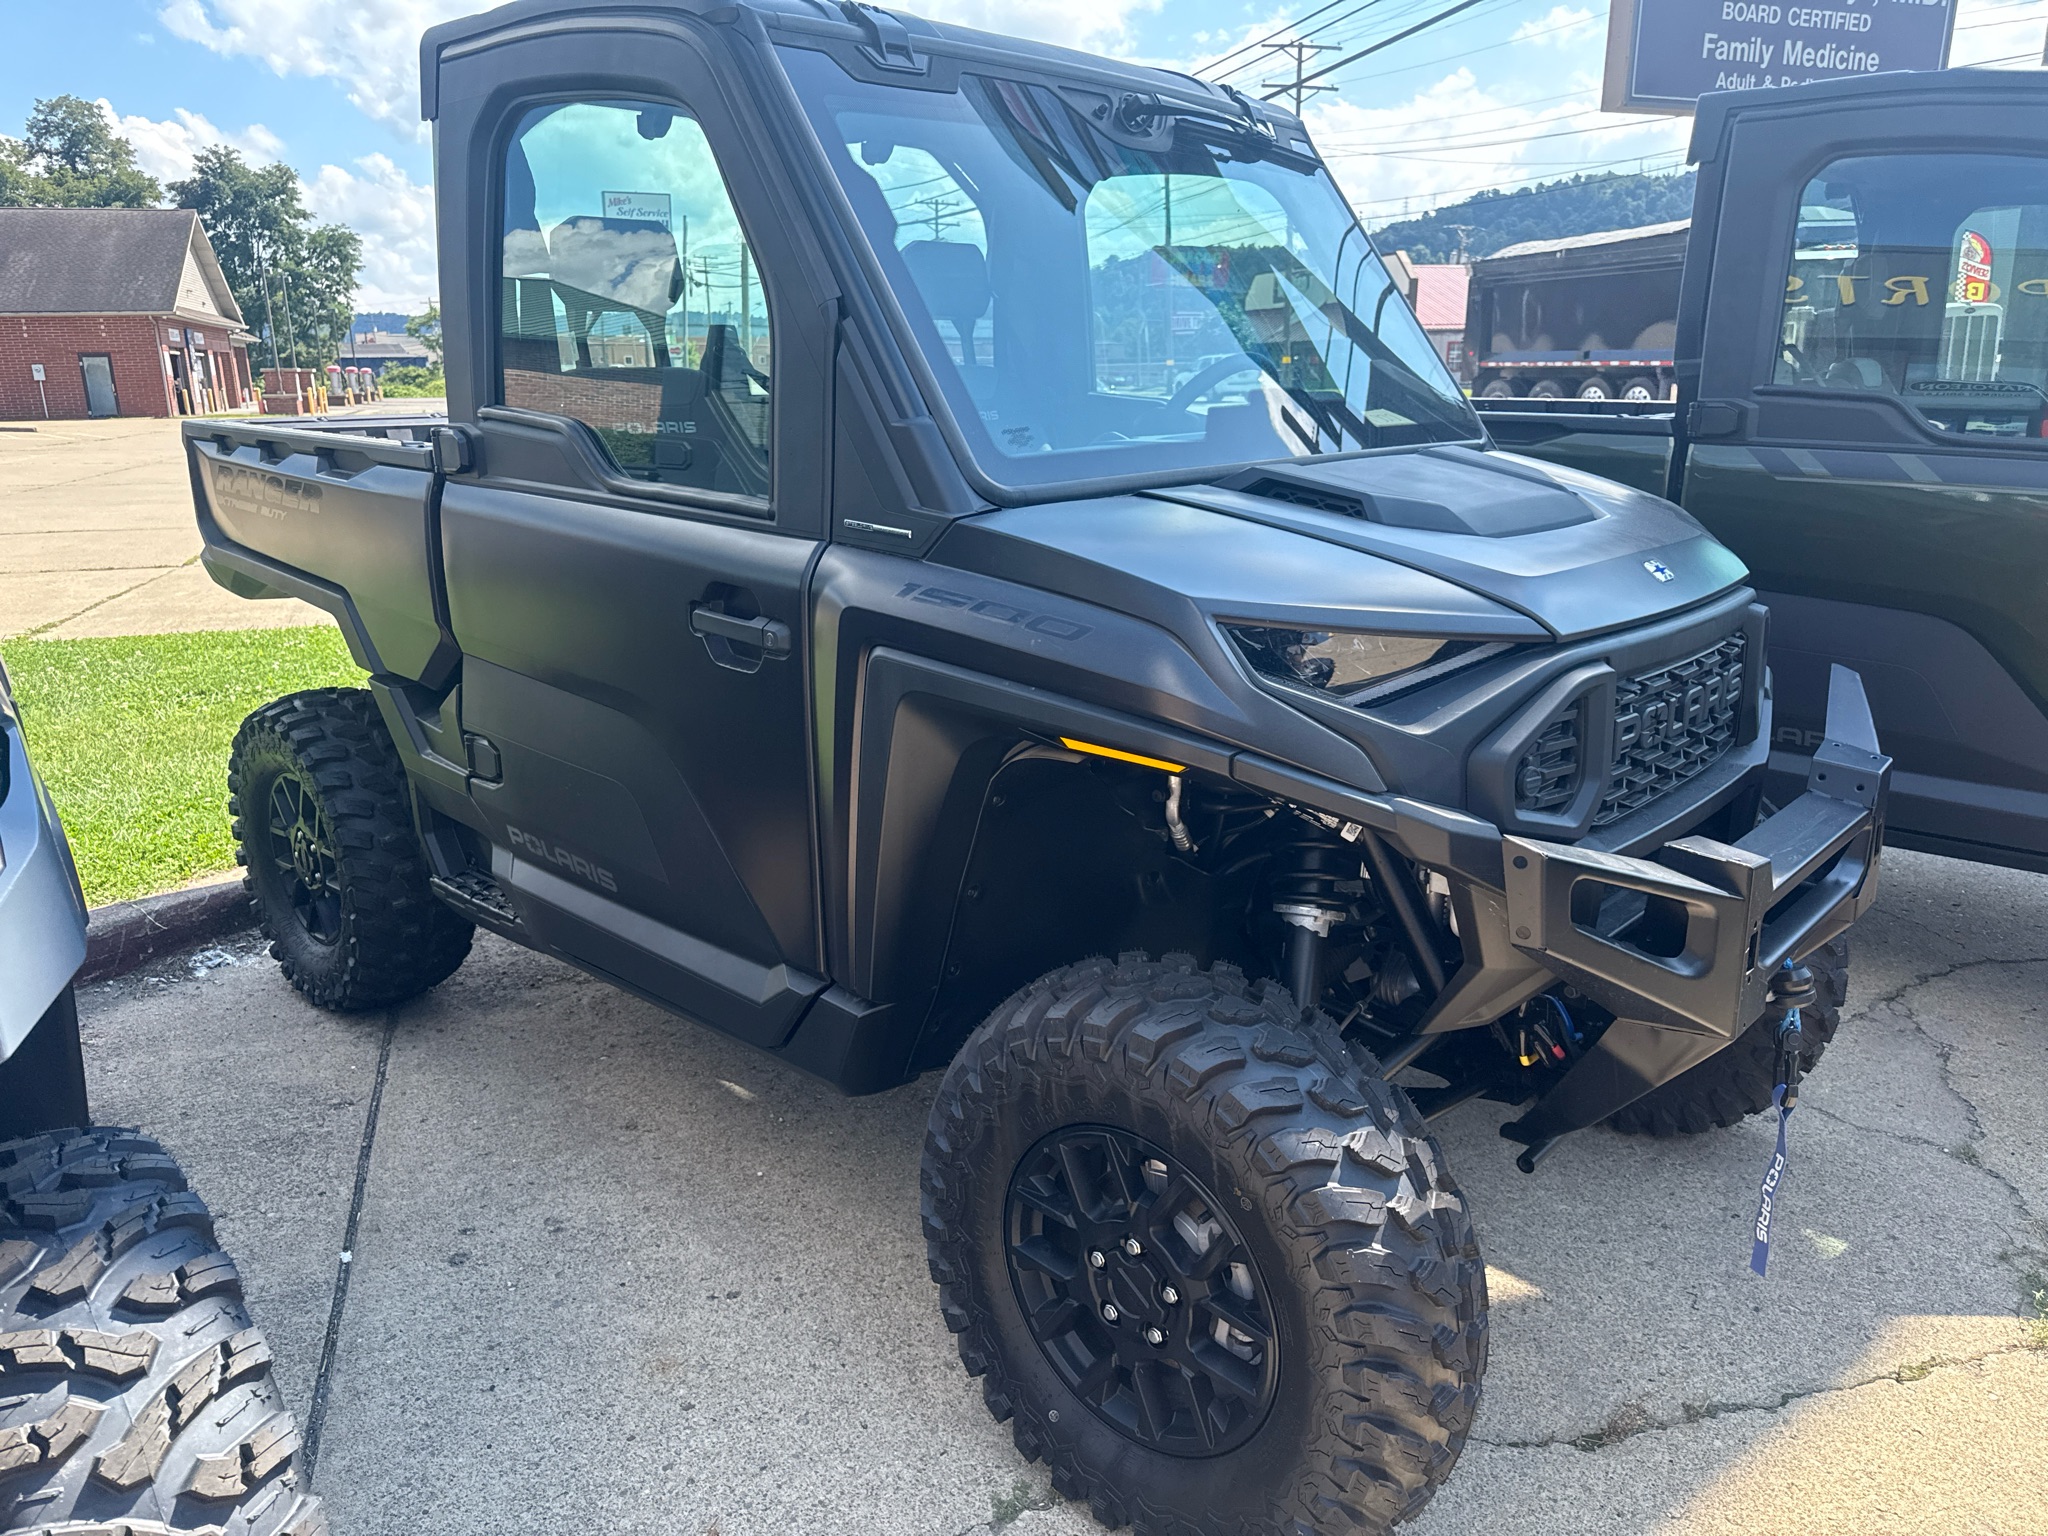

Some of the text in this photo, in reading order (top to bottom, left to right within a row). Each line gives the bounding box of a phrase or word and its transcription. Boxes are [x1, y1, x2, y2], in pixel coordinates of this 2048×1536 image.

[1722, 1, 1872, 33] BOARD CERTIFIED
[1702, 32, 1880, 72] Family Medicine
[1715, 71, 1756, 90] Adult
[607, 196, 632, 208] Mike's
[616, 206, 669, 218] Self Service
[612, 421, 697, 435] POLARIS
[216, 465, 323, 514] RANGER
[895, 582, 1096, 642] 1500
[1612, 662, 1743, 764] POLARIS
[506, 824, 618, 893] POLARIS
[1756, 1152, 1784, 1243] POLARIS
